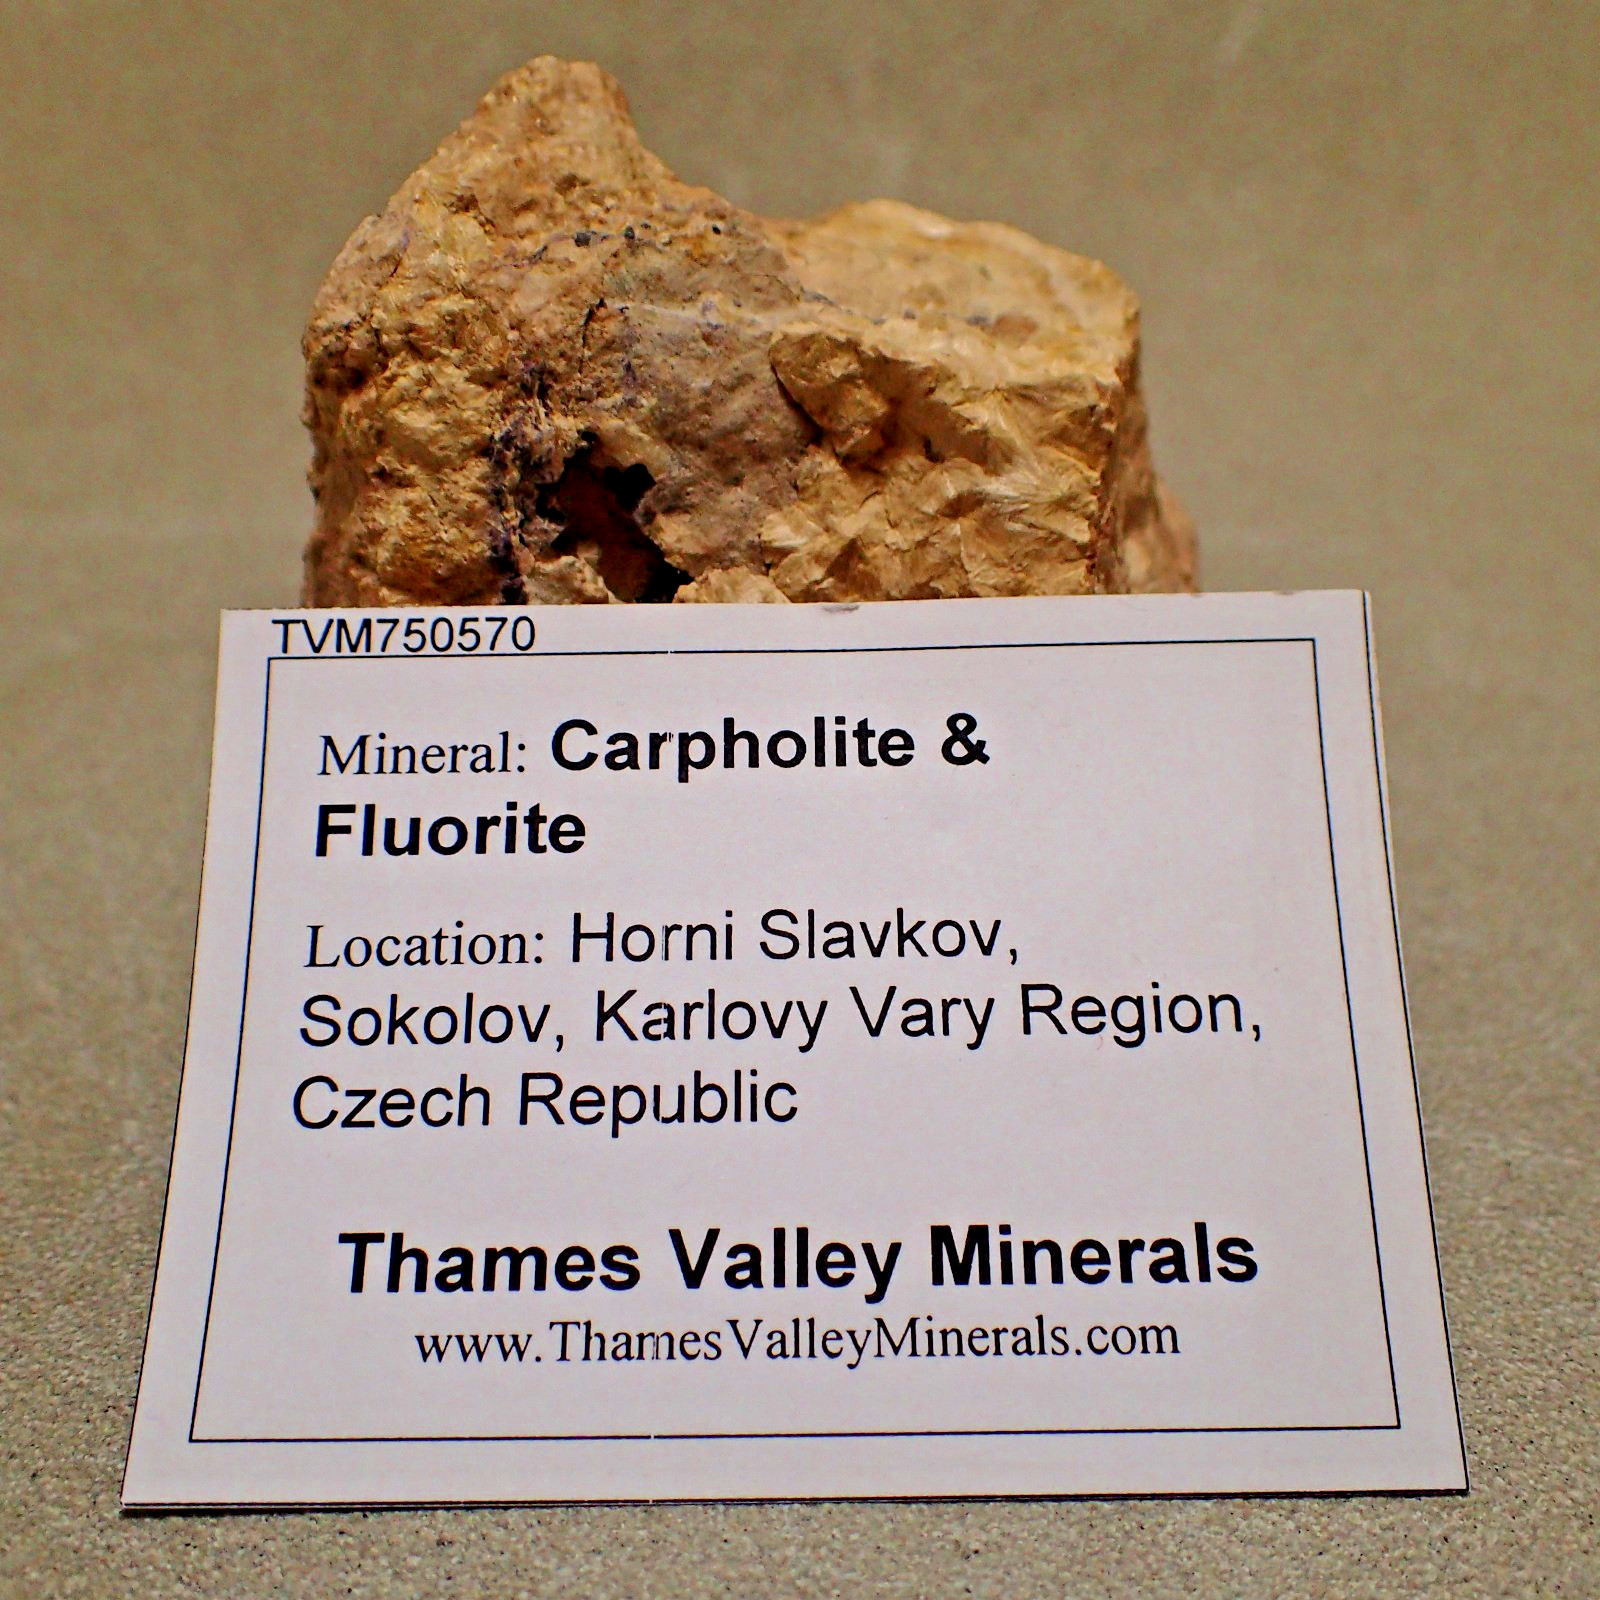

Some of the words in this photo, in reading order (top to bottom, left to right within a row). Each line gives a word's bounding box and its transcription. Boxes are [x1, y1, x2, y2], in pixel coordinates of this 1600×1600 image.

[272, 616, 535, 656] TVM750570
[318, 731, 527, 776] Mineral:
[552, 716, 914, 783] Carpholite
[942, 713, 990, 766] &
[316, 802, 586, 858] Fluorite
[303, 920, 544, 968] Location:
[573, 909, 733, 963] Horni
[760, 907, 1018, 966] Slavkov,
[300, 992, 564, 1052] Sokolov,
[596, 988, 829, 1054] Karlovy
[849, 985, 995, 1051] Vary
[1021, 981, 1261, 1049] Region,
[293, 1073, 491, 1129] Czech
[520, 1069, 798, 1138] Republic
[339, 1233, 641, 1293] Thames
[669, 1227, 902, 1305] Valley
[931, 1221, 1257, 1288] Minerals
[415, 1315, 1181, 1370] www.ThamesValleyMinerals.com
